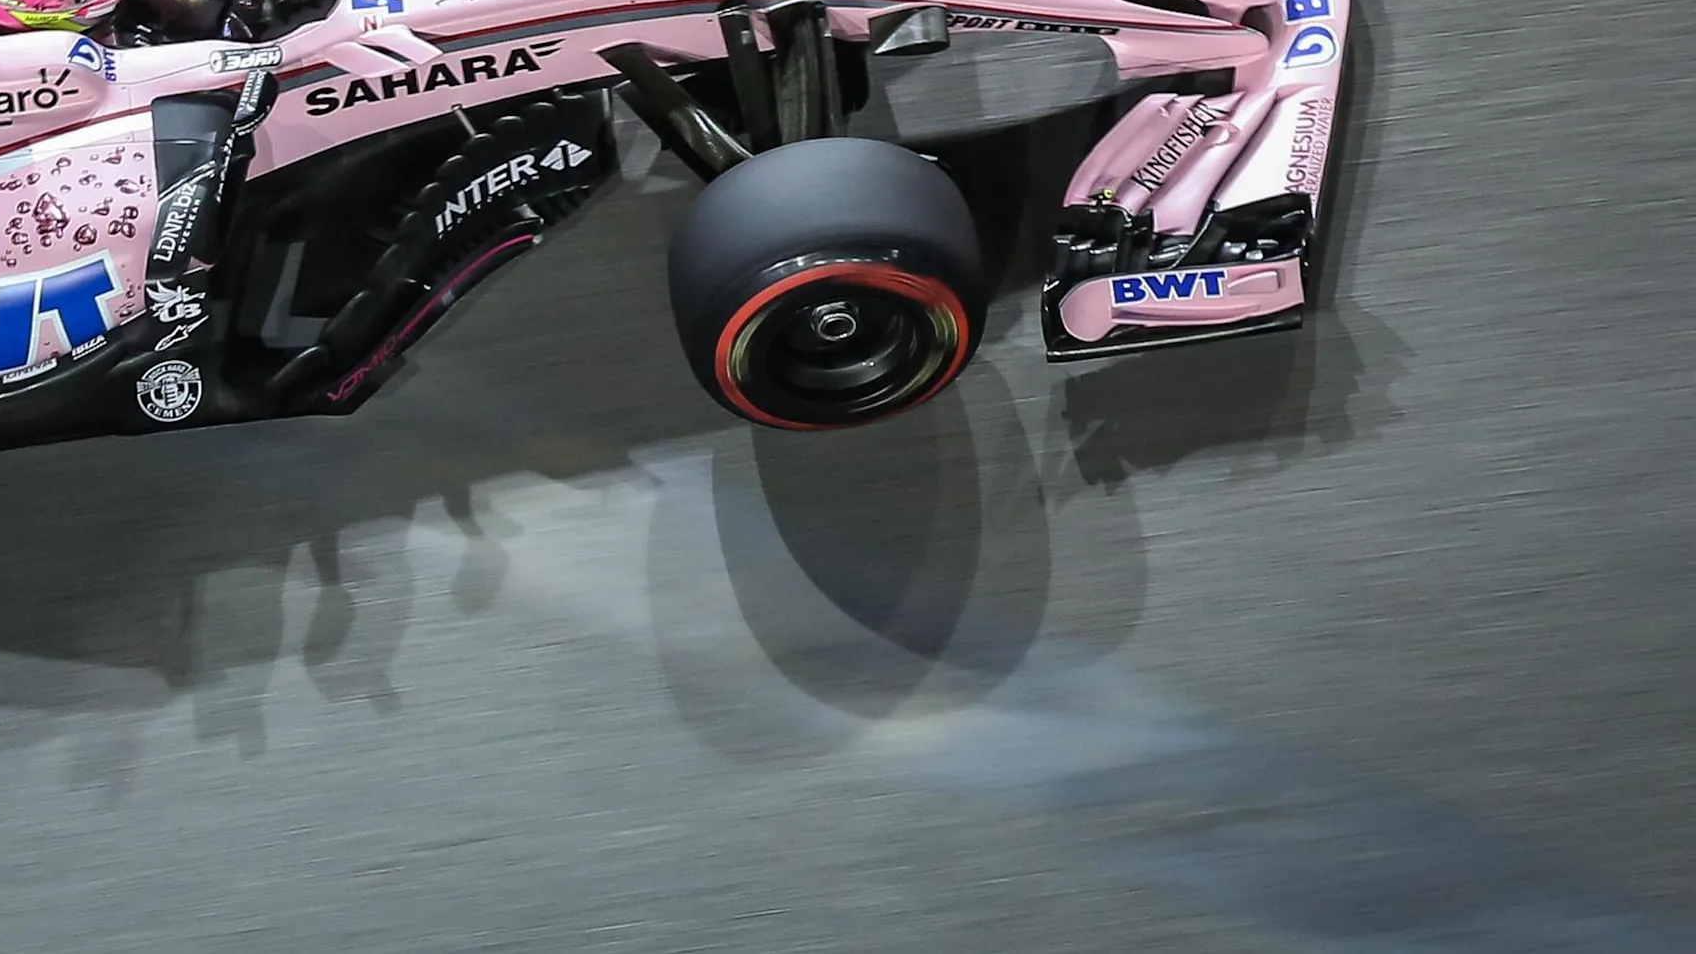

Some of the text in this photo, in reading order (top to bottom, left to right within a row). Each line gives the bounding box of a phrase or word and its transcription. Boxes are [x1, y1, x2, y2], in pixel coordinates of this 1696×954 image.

[104, 49, 118, 82] BWT
[224, 48, 281, 71] HYPE
[305, 46, 542, 118] SAHARA
[1130, 98, 1234, 194] KINGFISHER
[1284, 98, 1319, 194] AGNESIUM
[434, 153, 539, 234] INTER
[152, 182, 199, 262] LDNR.biz
[177, 198, 202, 253] EYEWEAR
[1112, 271, 1226, 305] BWT
[71, 334, 106, 357] IBIZA
[146, 392, 197, 418] CEMENT
